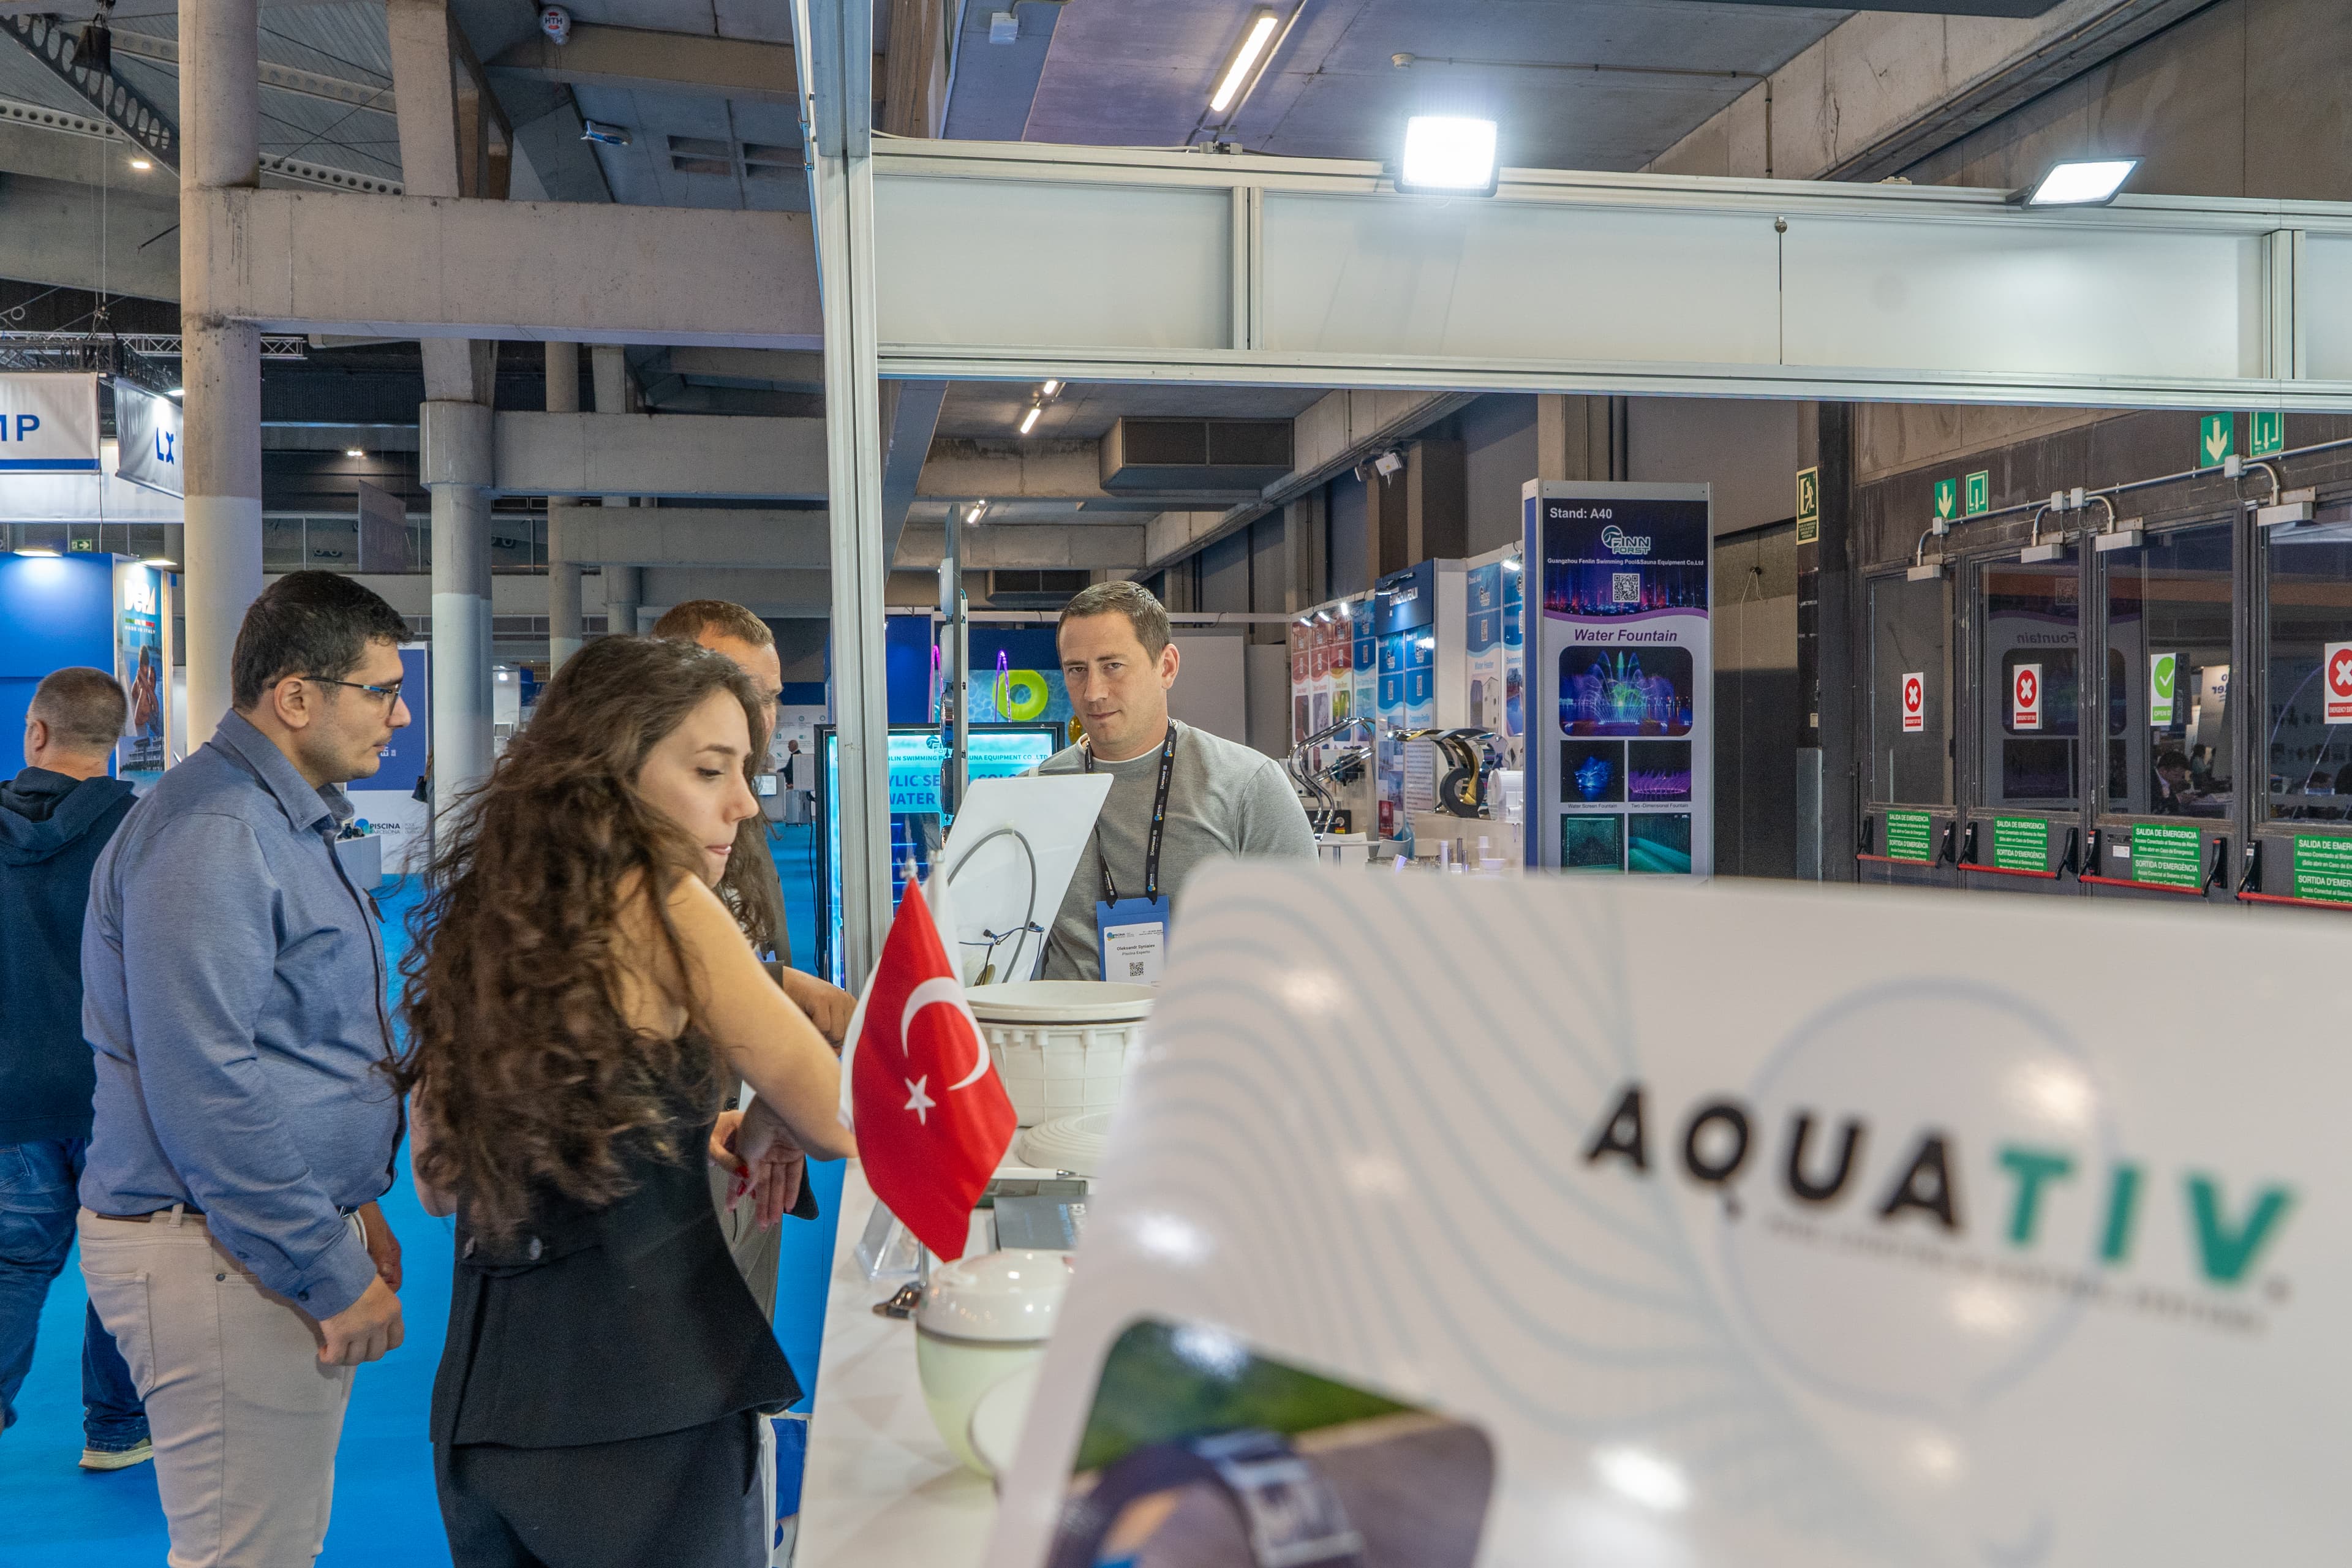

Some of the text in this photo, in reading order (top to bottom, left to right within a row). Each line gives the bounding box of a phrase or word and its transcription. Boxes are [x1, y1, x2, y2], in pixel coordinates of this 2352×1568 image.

[1550, 508, 1612, 519] Stand: A40
[1611, 537, 1651, 547] FINN
[1574, 629, 1677, 641] Water Fountain
[2163, 830, 2197, 839] EMERGENCIA
[2299, 839, 2352, 851] SALIDA DE EMER
[2135, 860, 2157, 869] SORTIDA
[2298, 875, 2352, 888] SORTIDA D'EMER
[1580, 1083, 2298, 1290] AQUATIV
